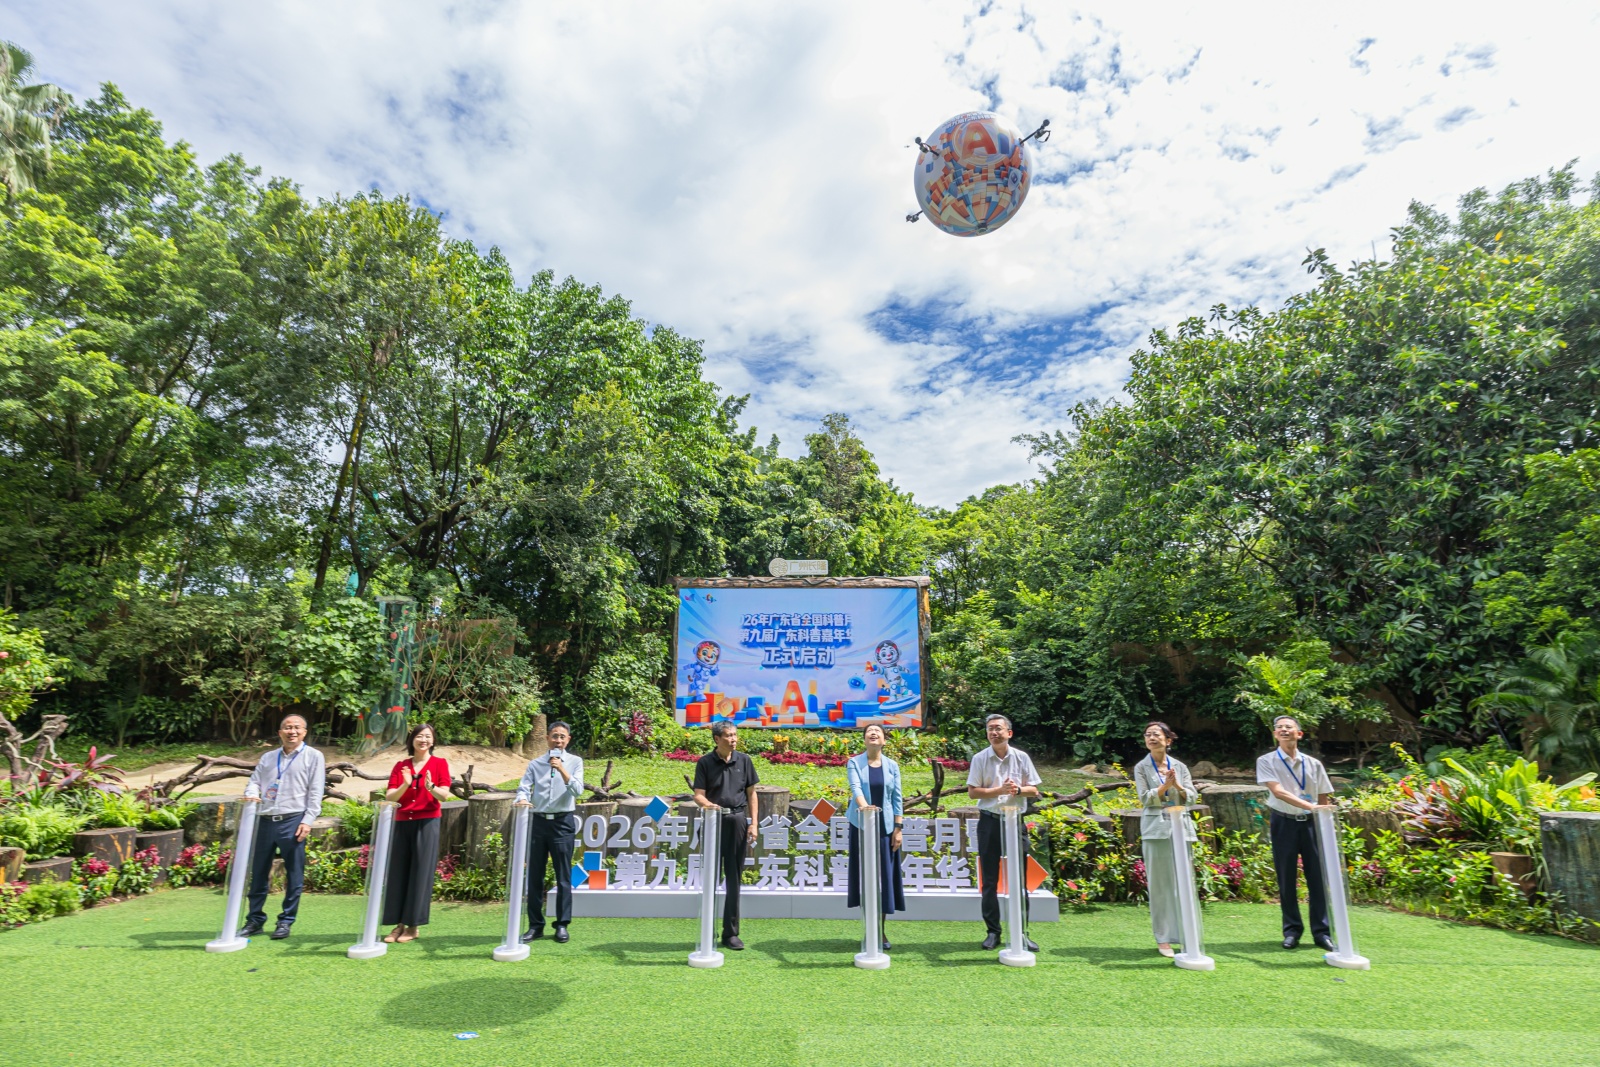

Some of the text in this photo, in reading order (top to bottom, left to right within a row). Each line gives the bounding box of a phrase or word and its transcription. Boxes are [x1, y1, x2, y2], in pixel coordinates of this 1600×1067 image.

[762, 646, 835, 665] 正式启动
[780, 680, 818, 713] AI
[573, 814, 980, 853] 026年省全国普月
[612, 852, 971, 893] 第九届东科普年华
